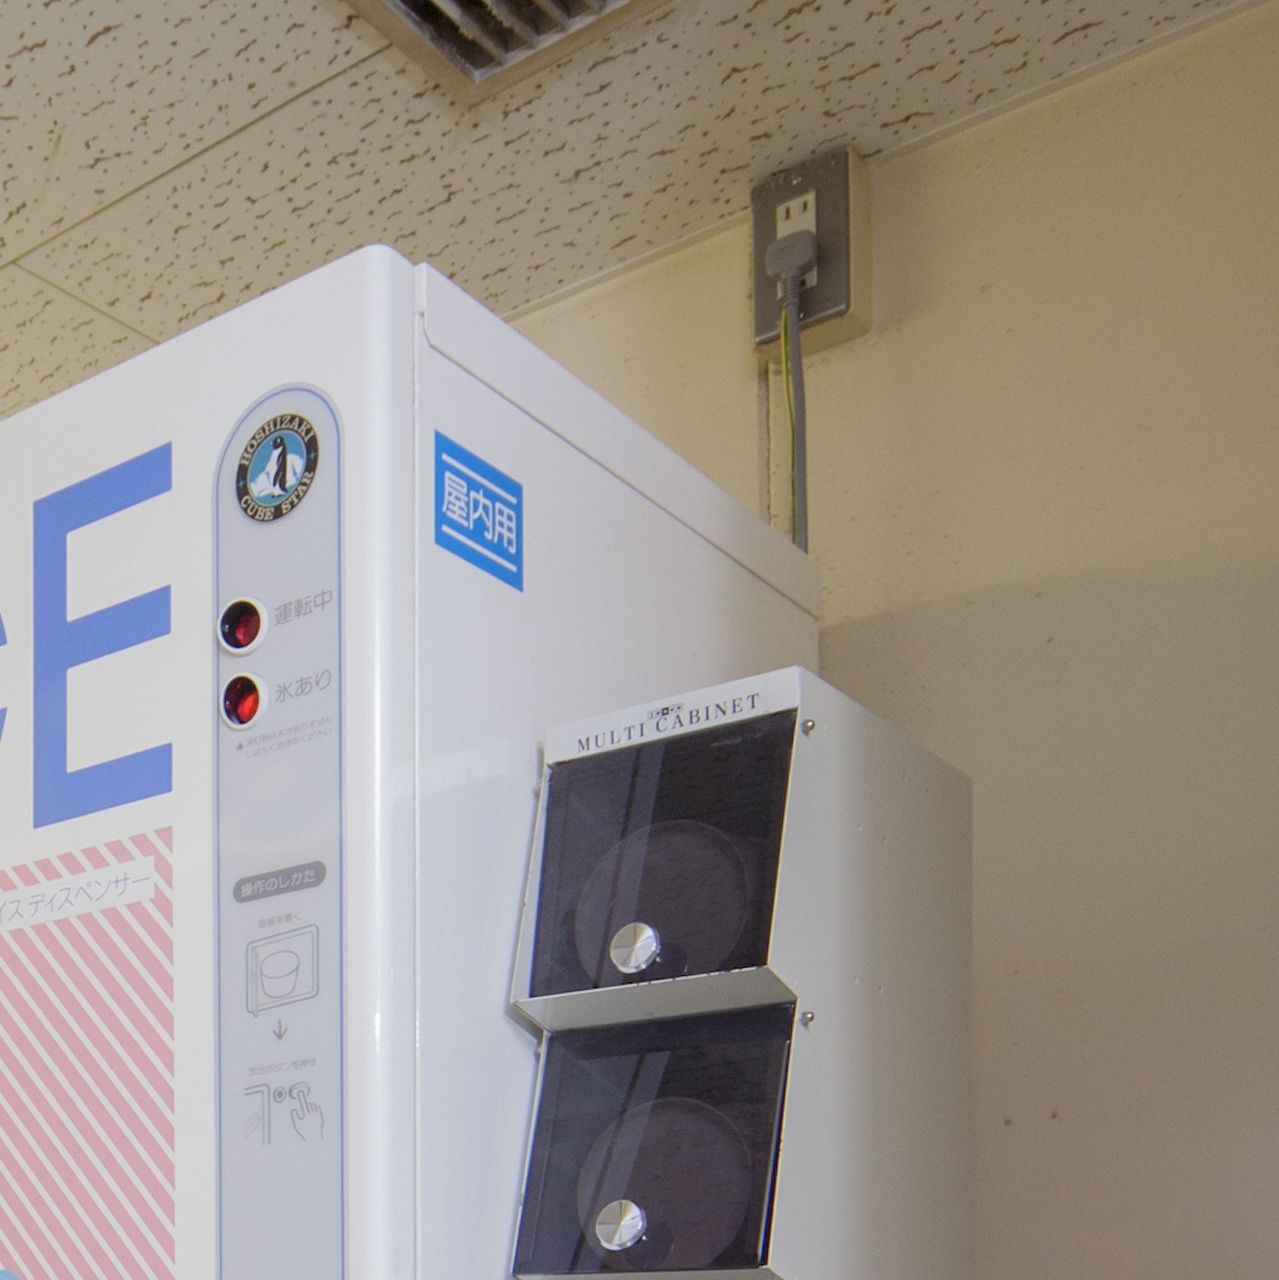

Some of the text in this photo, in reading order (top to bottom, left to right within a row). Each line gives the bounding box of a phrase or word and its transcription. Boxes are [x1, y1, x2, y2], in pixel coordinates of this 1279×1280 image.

[240, 415, 316, 467] HOSHIZAKI
[240, 471, 315, 521] CUBE STAR
[442, 470, 517, 556] 屋内用
[274, 588, 333, 627] 運転中
[274, 668, 333, 703] 氷あり
[576, 722, 645, 753] MULTI
[655, 692, 760, 733] CABINET
